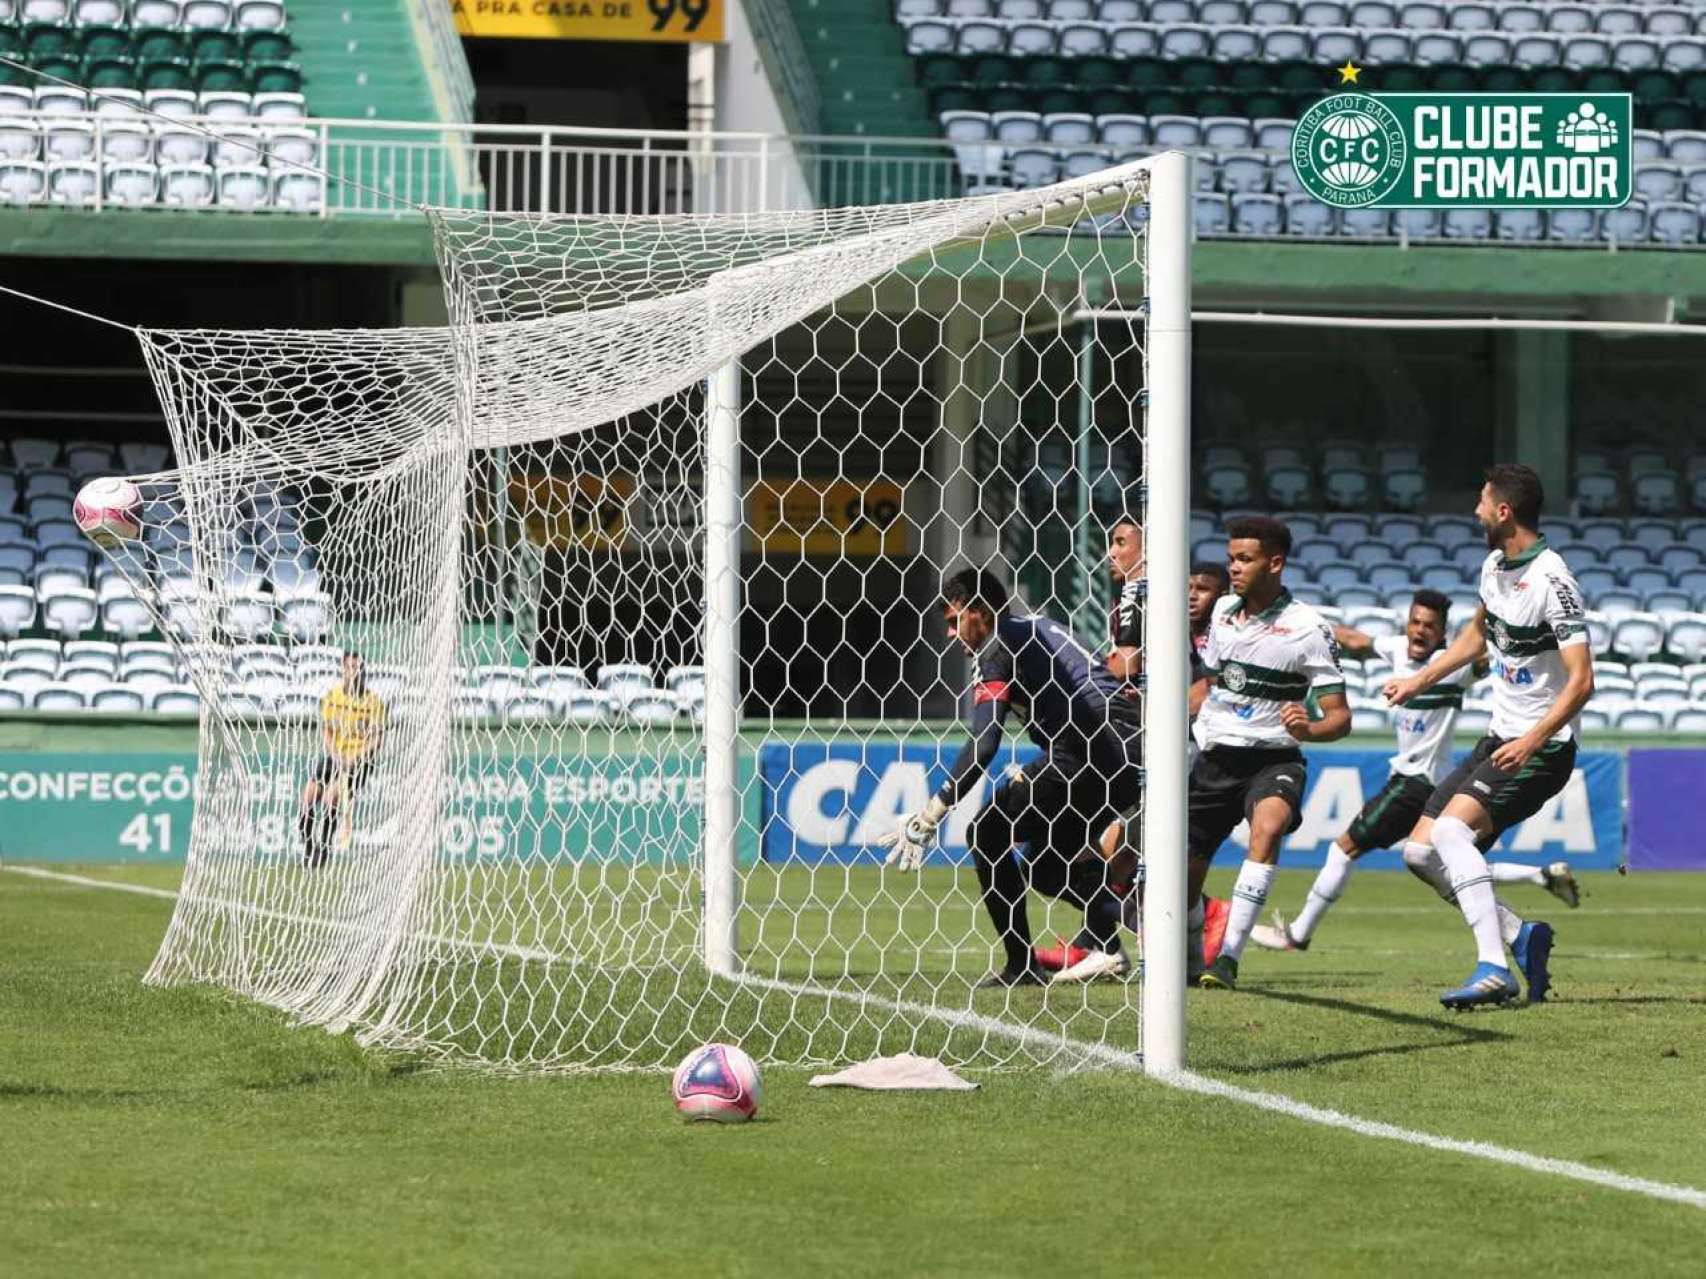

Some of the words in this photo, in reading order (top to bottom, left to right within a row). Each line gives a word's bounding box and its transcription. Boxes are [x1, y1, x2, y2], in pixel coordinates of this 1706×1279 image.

[476, 1, 522, 15] PRA
[532, 2, 594, 17] CASA
[602, 3, 632, 18] DE
[646, 0, 709, 33] 99
[0, 765, 244, 805] ONFECÇÕ
[119, 812, 172, 852] 41
